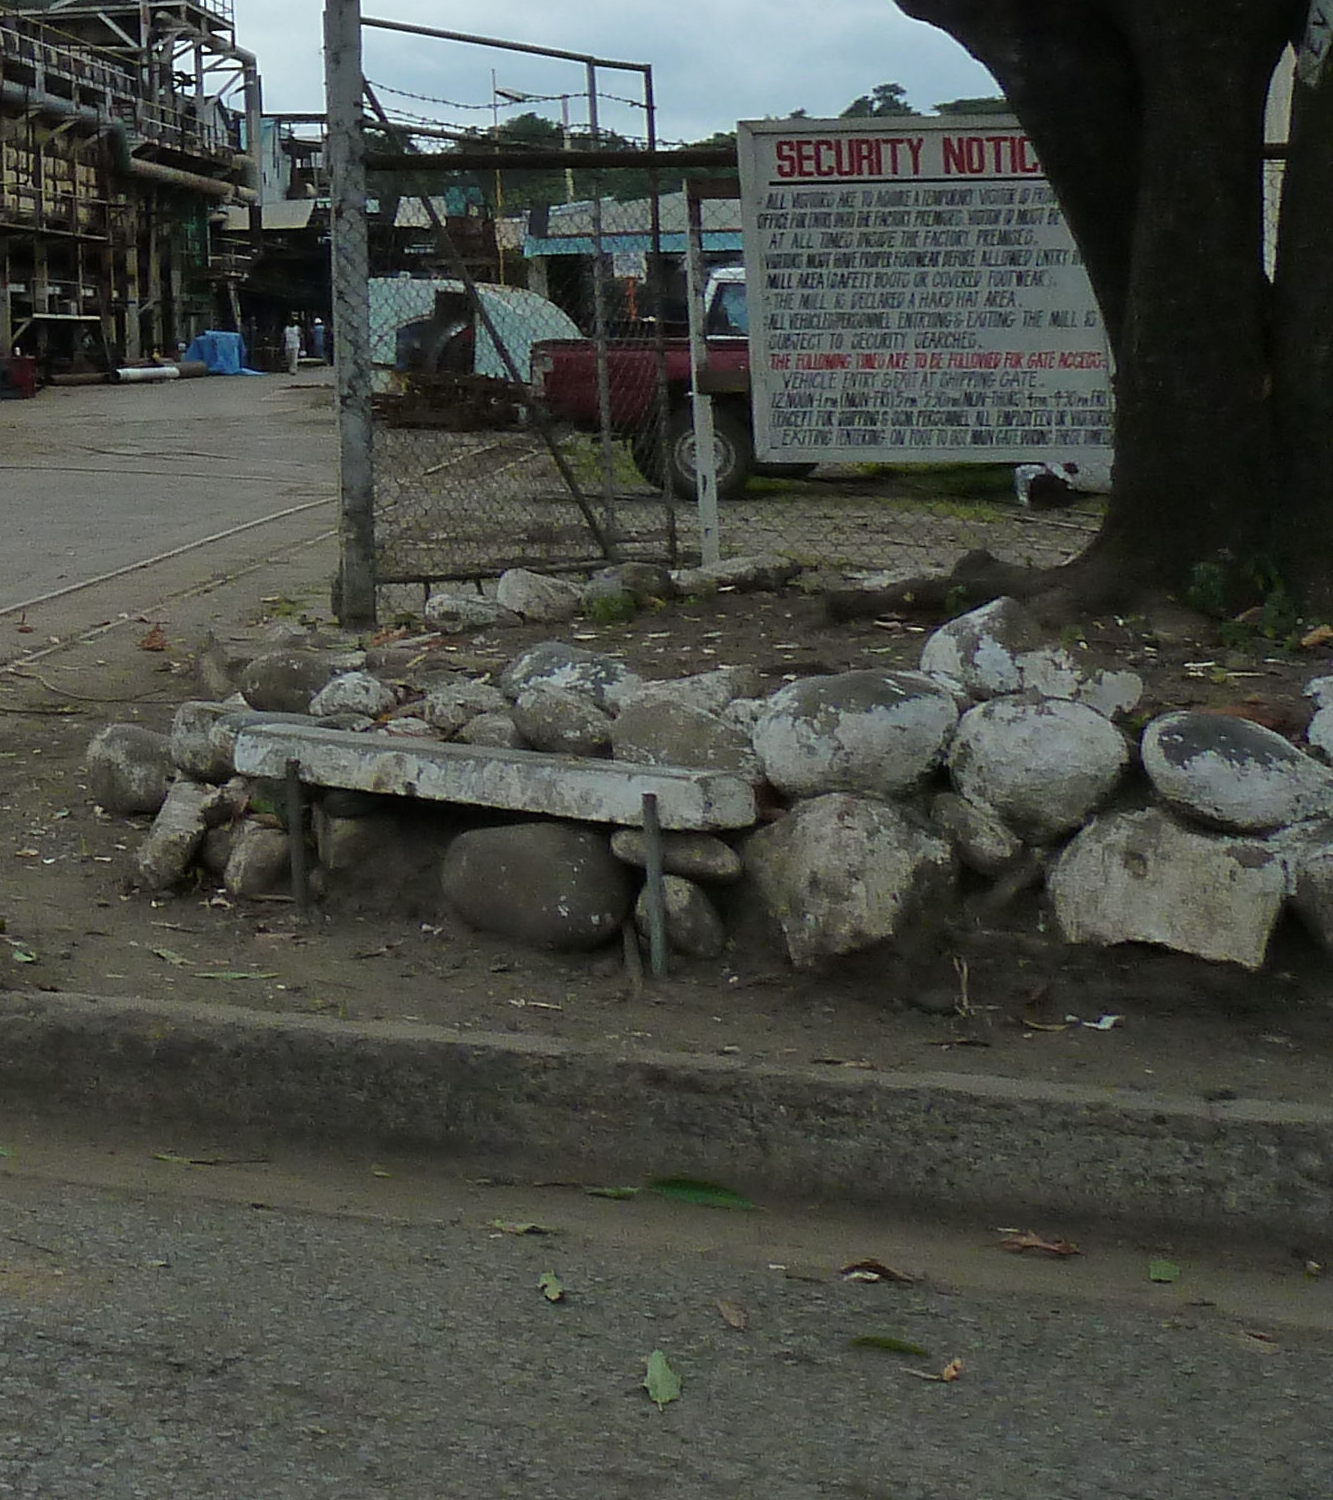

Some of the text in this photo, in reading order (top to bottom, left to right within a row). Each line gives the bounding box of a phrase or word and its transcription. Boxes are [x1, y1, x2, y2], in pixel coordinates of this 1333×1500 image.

[776, 135, 1042, 178] SECURITY NOTIC
[1021, 310, 1045, 328] THE
[1047, 310, 1079, 328] MILL
[829, 333, 844, 350] TO
[850, 332, 908, 350] SECURITY
[783, 372, 839, 390] VEHICLE
